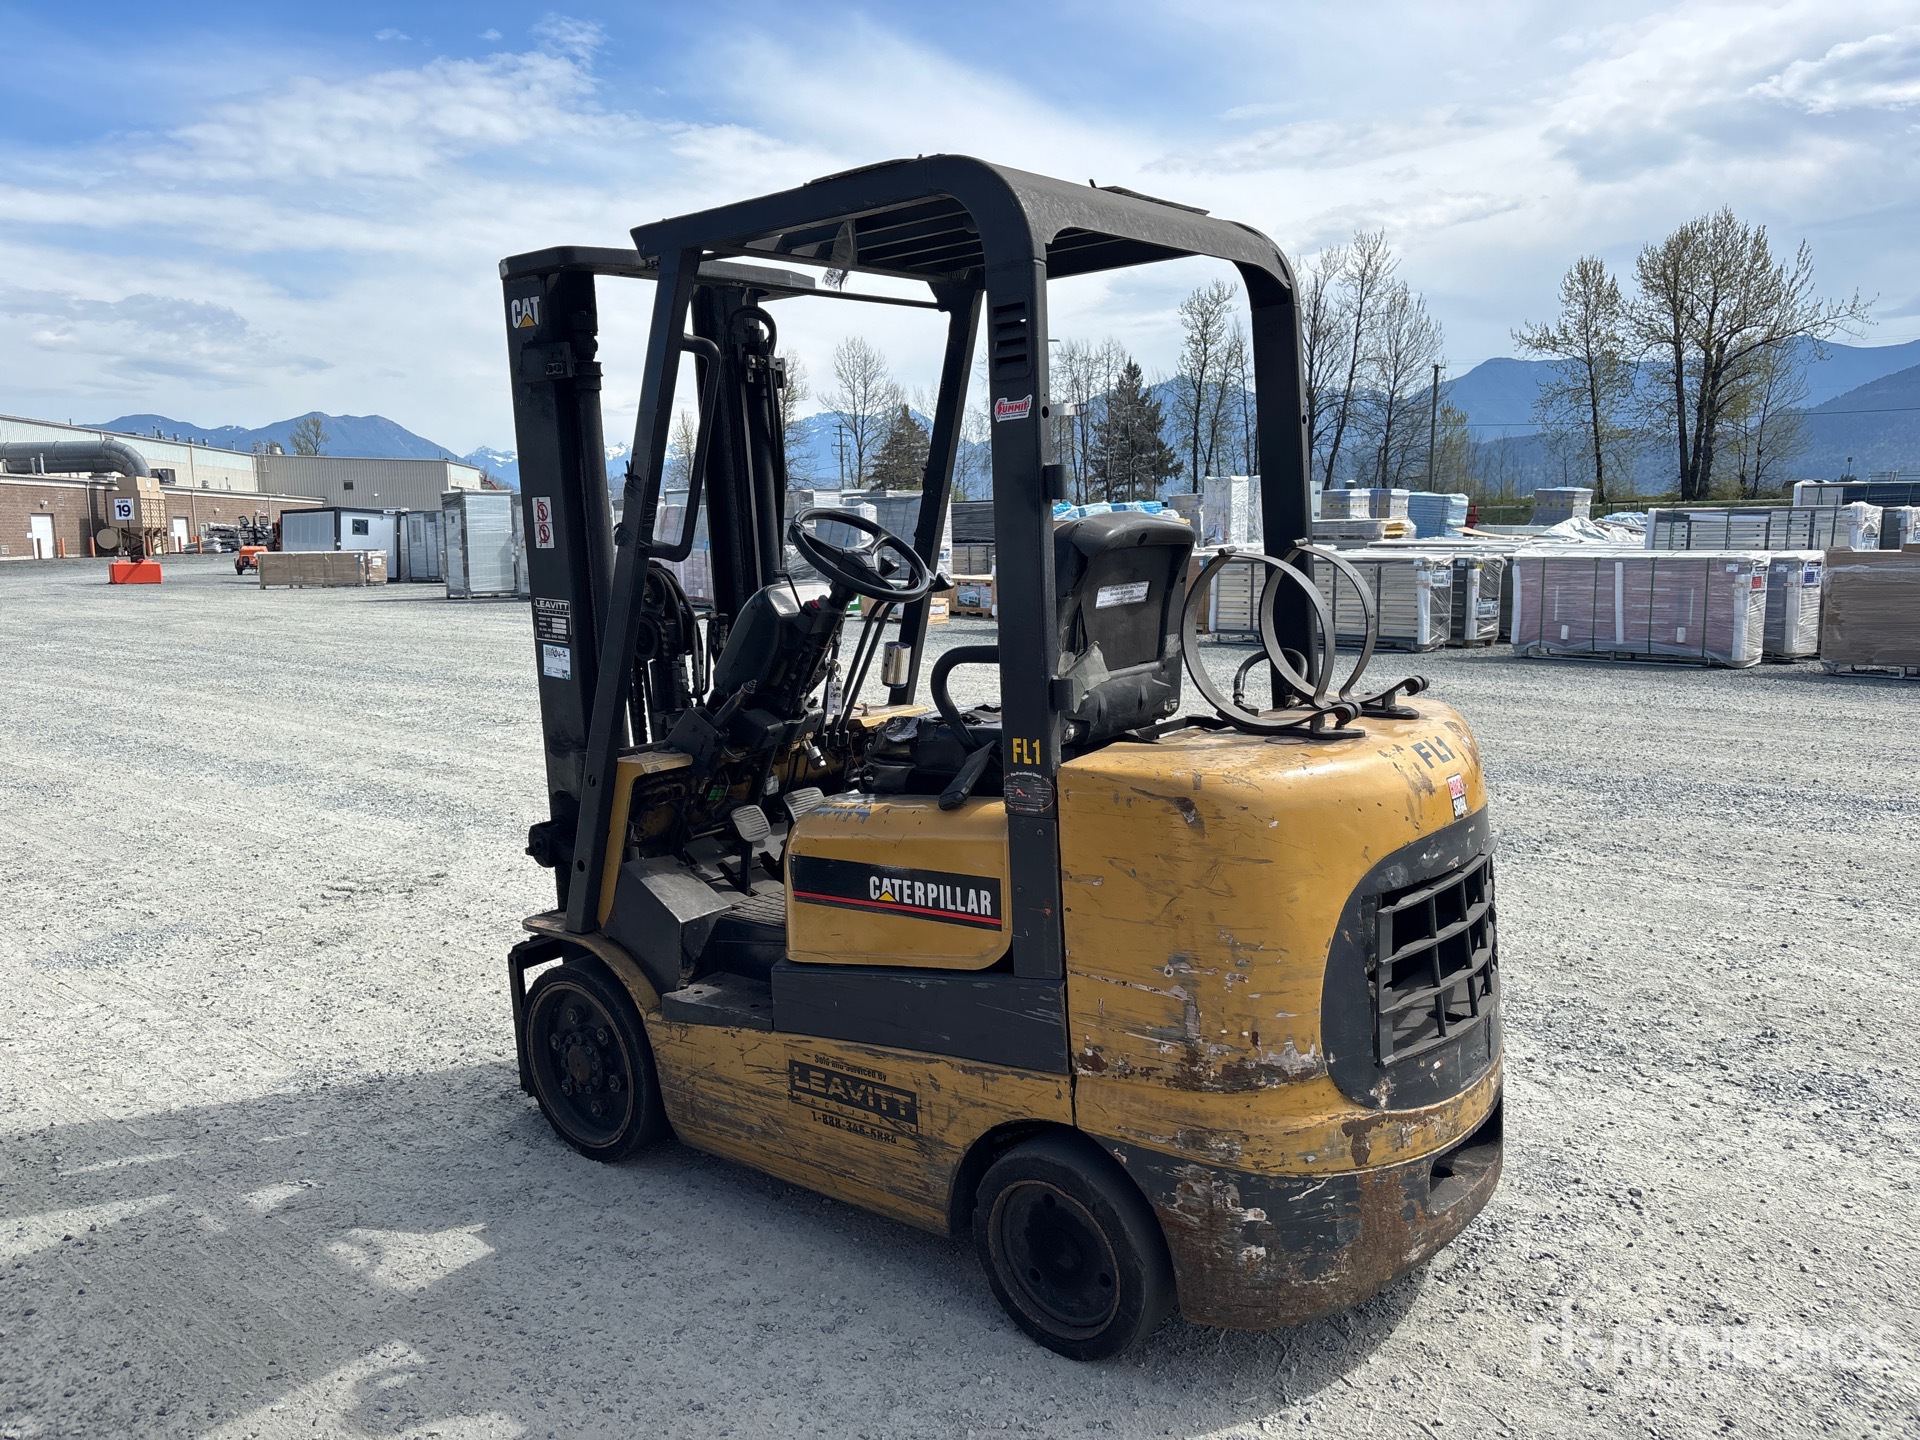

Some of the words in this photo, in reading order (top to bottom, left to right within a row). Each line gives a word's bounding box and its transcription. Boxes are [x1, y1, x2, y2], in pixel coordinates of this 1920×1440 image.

[511, 296, 540, 329] CAT
[998, 400, 1029, 414] SUMMIT
[116, 504, 131, 517] 19
[535, 599, 568, 610] LEAVITT
[1012, 737, 1041, 765] FL1
[1411, 735, 1456, 769] FL1
[869, 875, 992, 916] CATERPILLAR
[814, 1054, 830, 1066] Sold
[793, 1066, 913, 1116] LEAVITT
